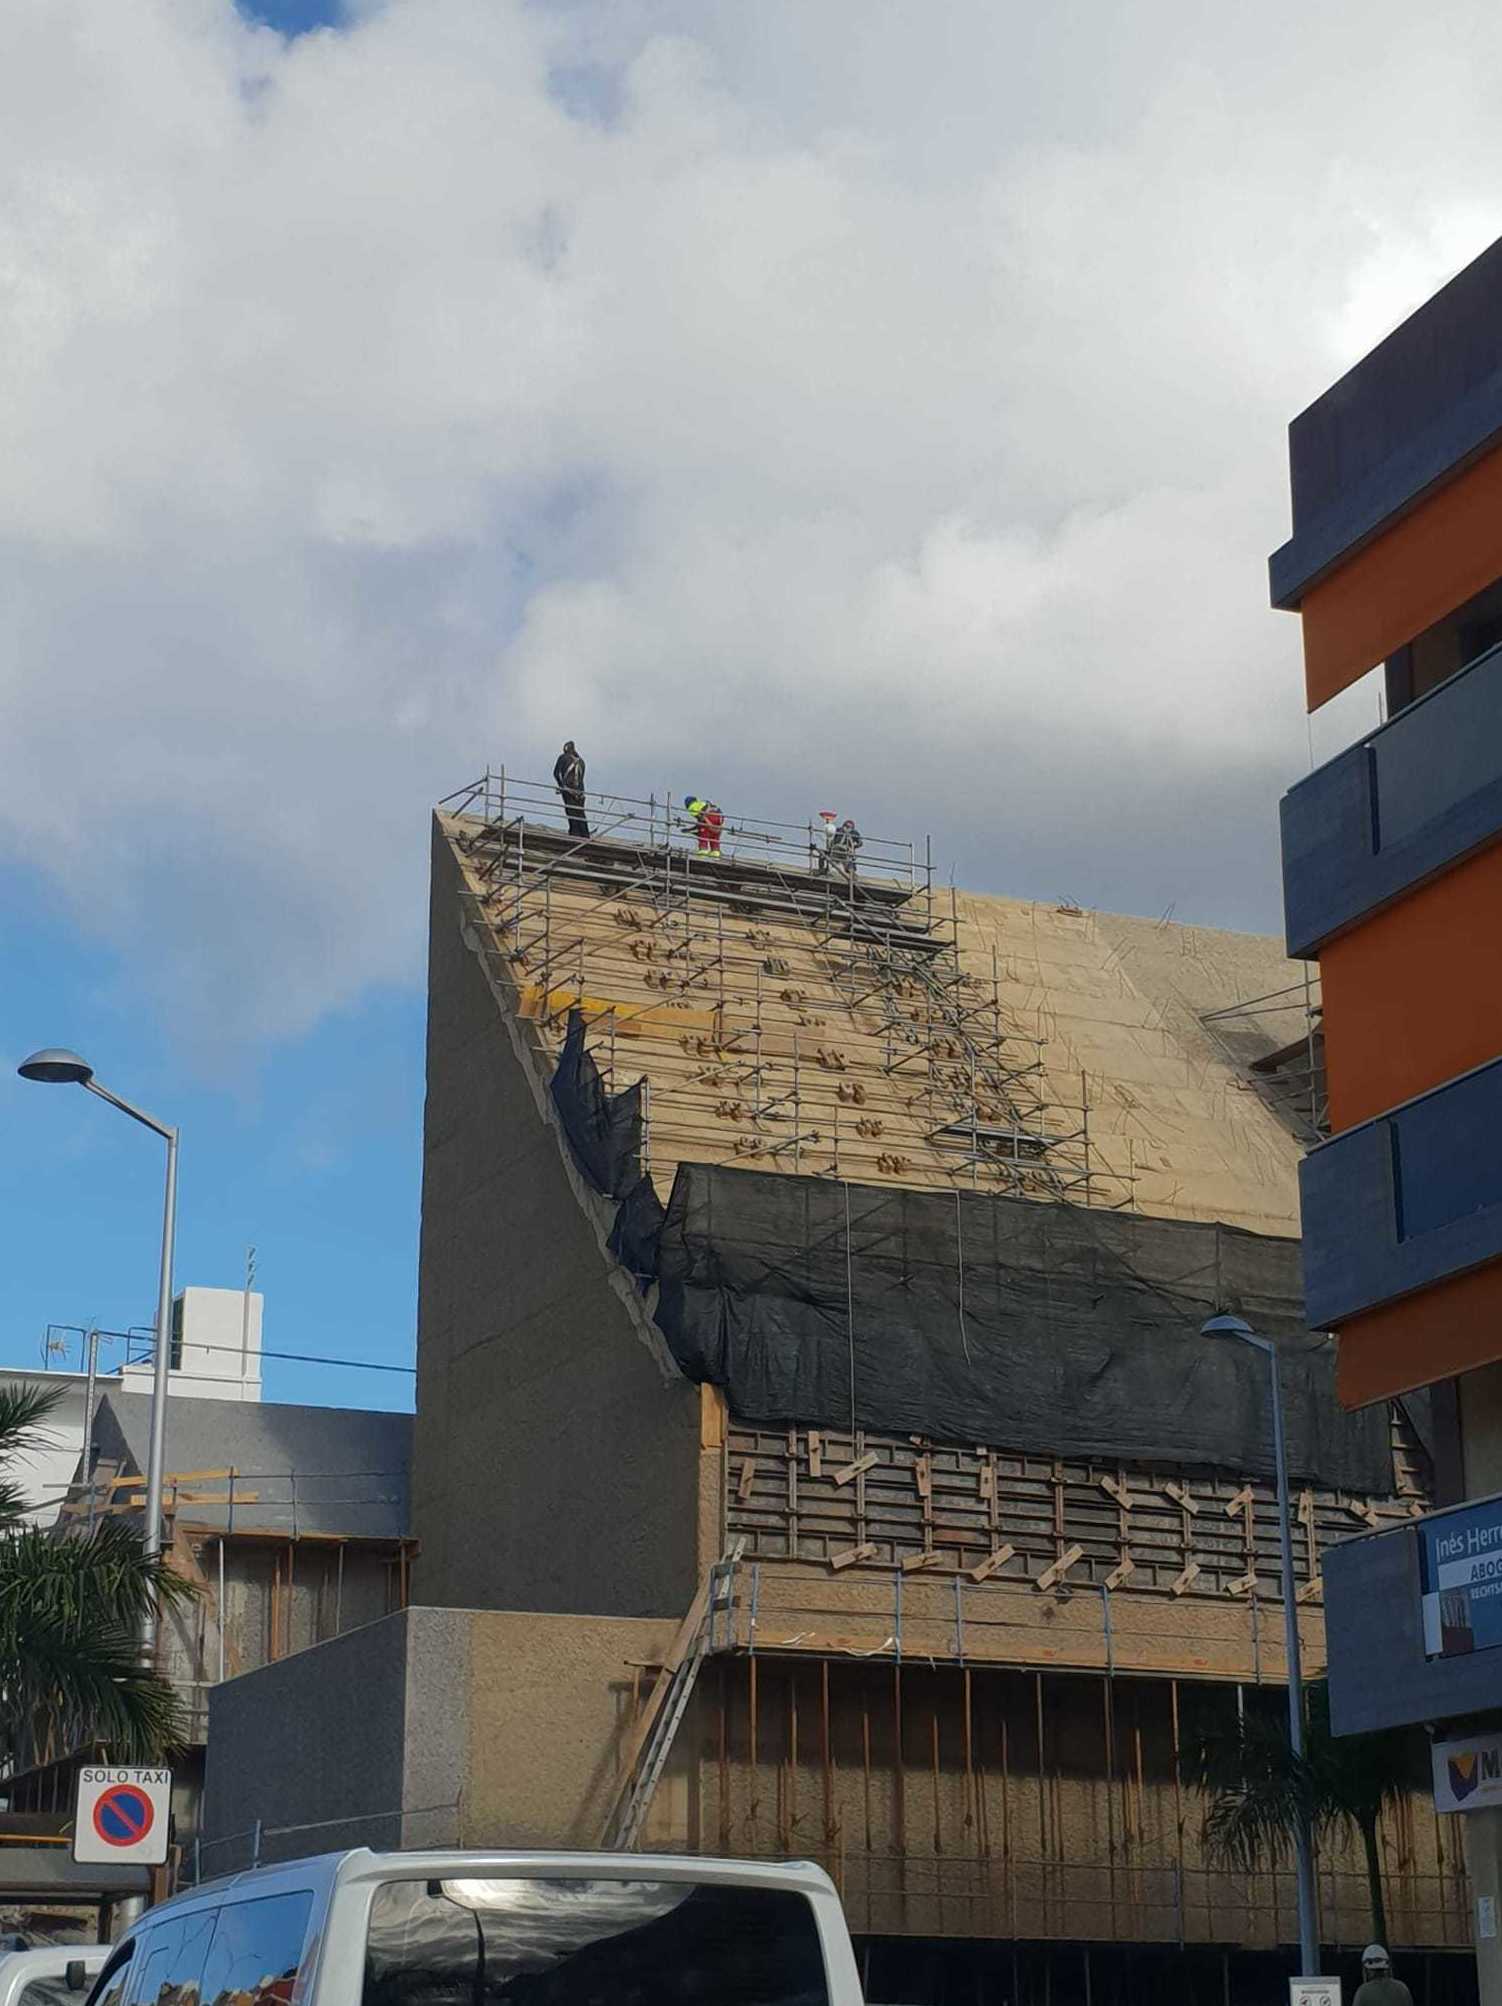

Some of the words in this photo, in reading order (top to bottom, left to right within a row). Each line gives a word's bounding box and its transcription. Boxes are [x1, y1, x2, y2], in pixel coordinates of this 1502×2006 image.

[1435, 1531, 1464, 1563] Inés
[1466, 1526, 1502, 1555] Herr
[83, 1769, 129, 1783] SOLO
[133, 1770, 168, 1784] TAXI
